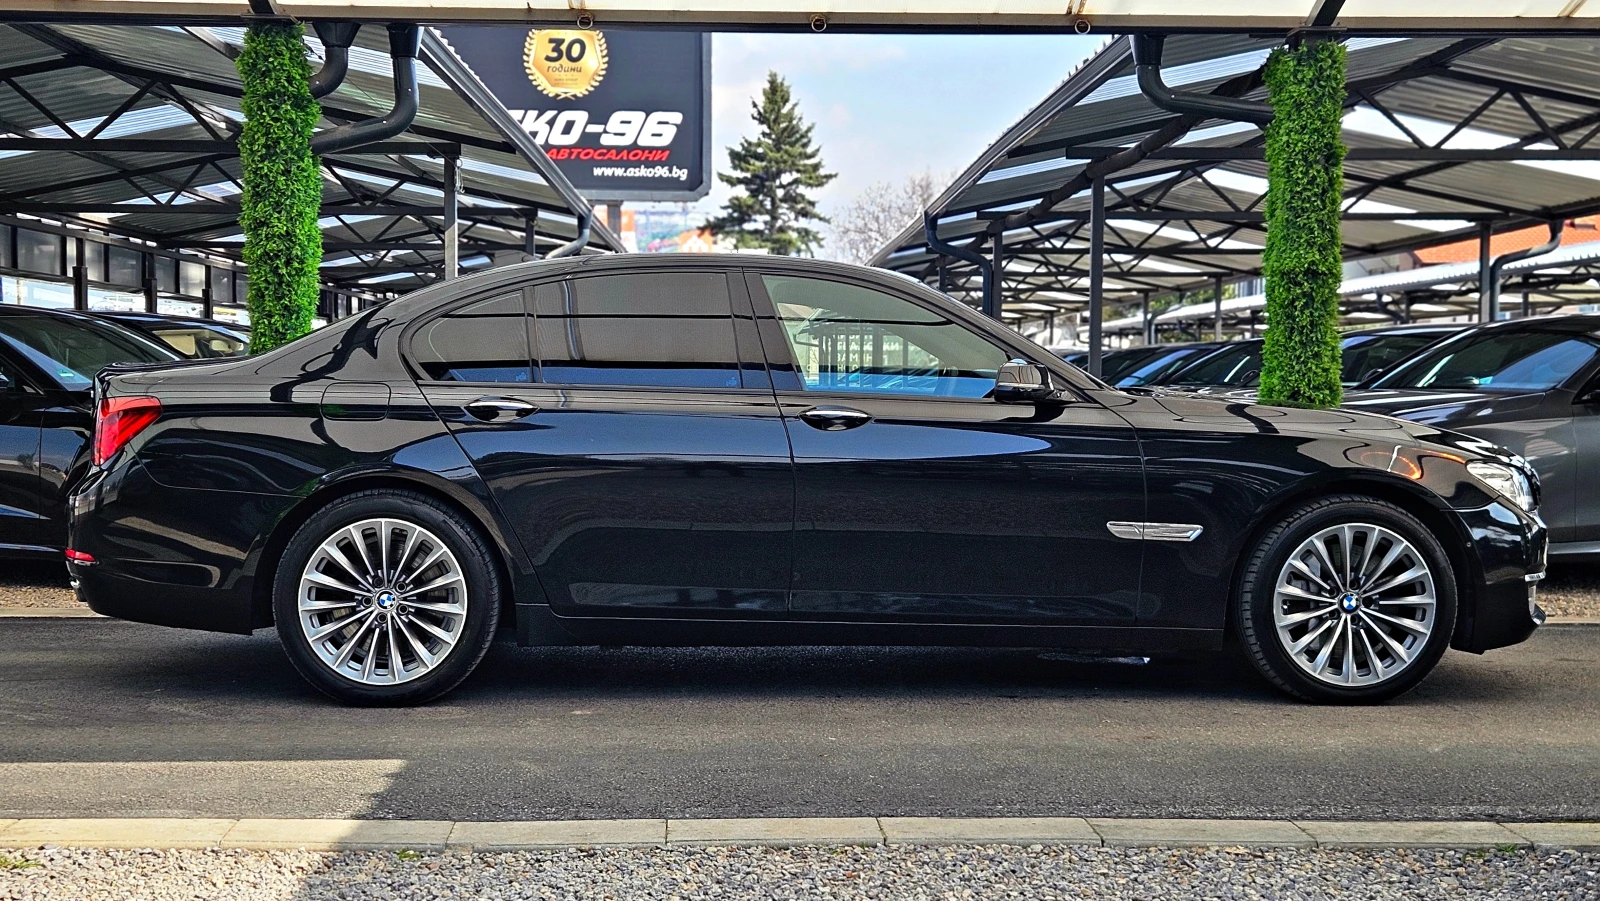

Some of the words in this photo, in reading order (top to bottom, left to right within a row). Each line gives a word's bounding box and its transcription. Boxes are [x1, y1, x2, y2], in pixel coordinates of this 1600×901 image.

[544, 37, 586, 63] 30
[546, 63, 583, 73] години
[546, 148, 671, 161] АВТОСАЛОНИ
[593, 165, 688, 180] www.asko96.bg
